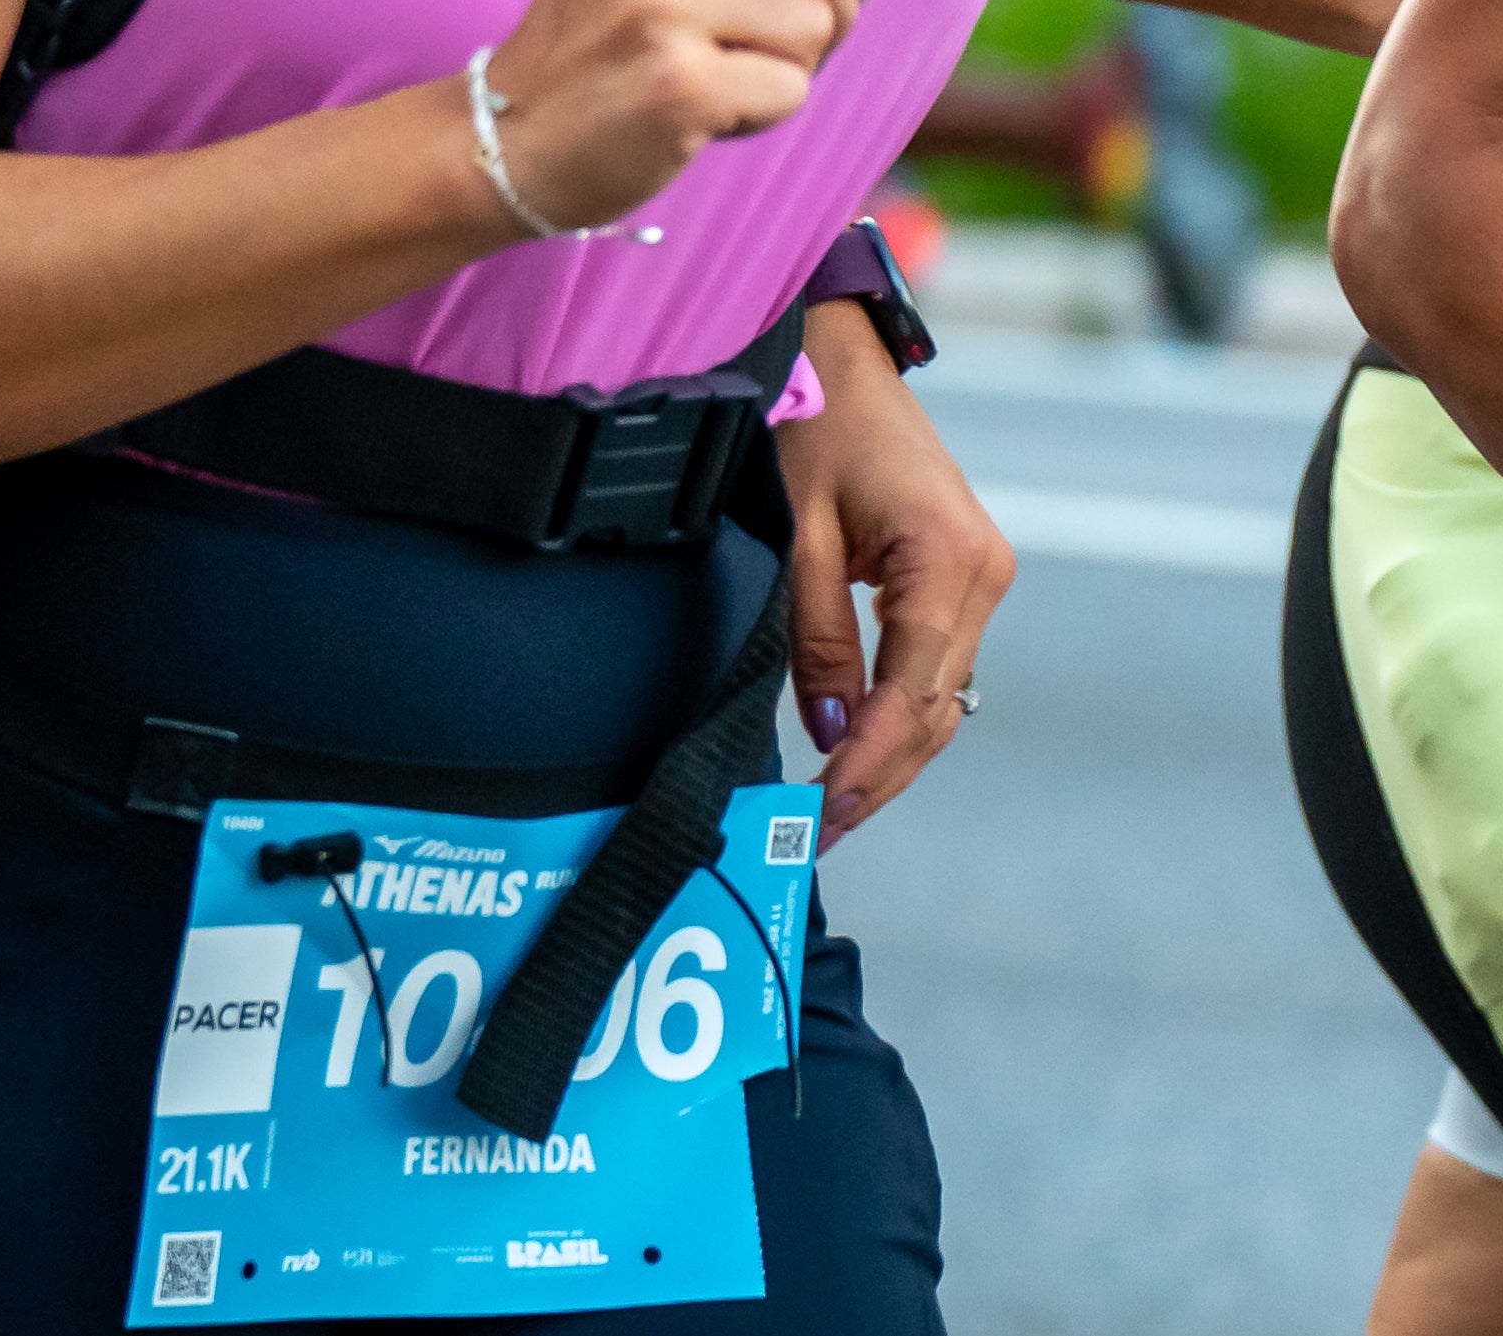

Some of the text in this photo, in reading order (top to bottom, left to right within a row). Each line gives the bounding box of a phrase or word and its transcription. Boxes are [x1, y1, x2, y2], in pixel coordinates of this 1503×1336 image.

[320, 859, 529, 918] ATHENAS
[174, 1000, 281, 1033] PACER
[157, 1141, 252, 1194] 21.1K
[403, 1133, 596, 1176] FERNANDA
